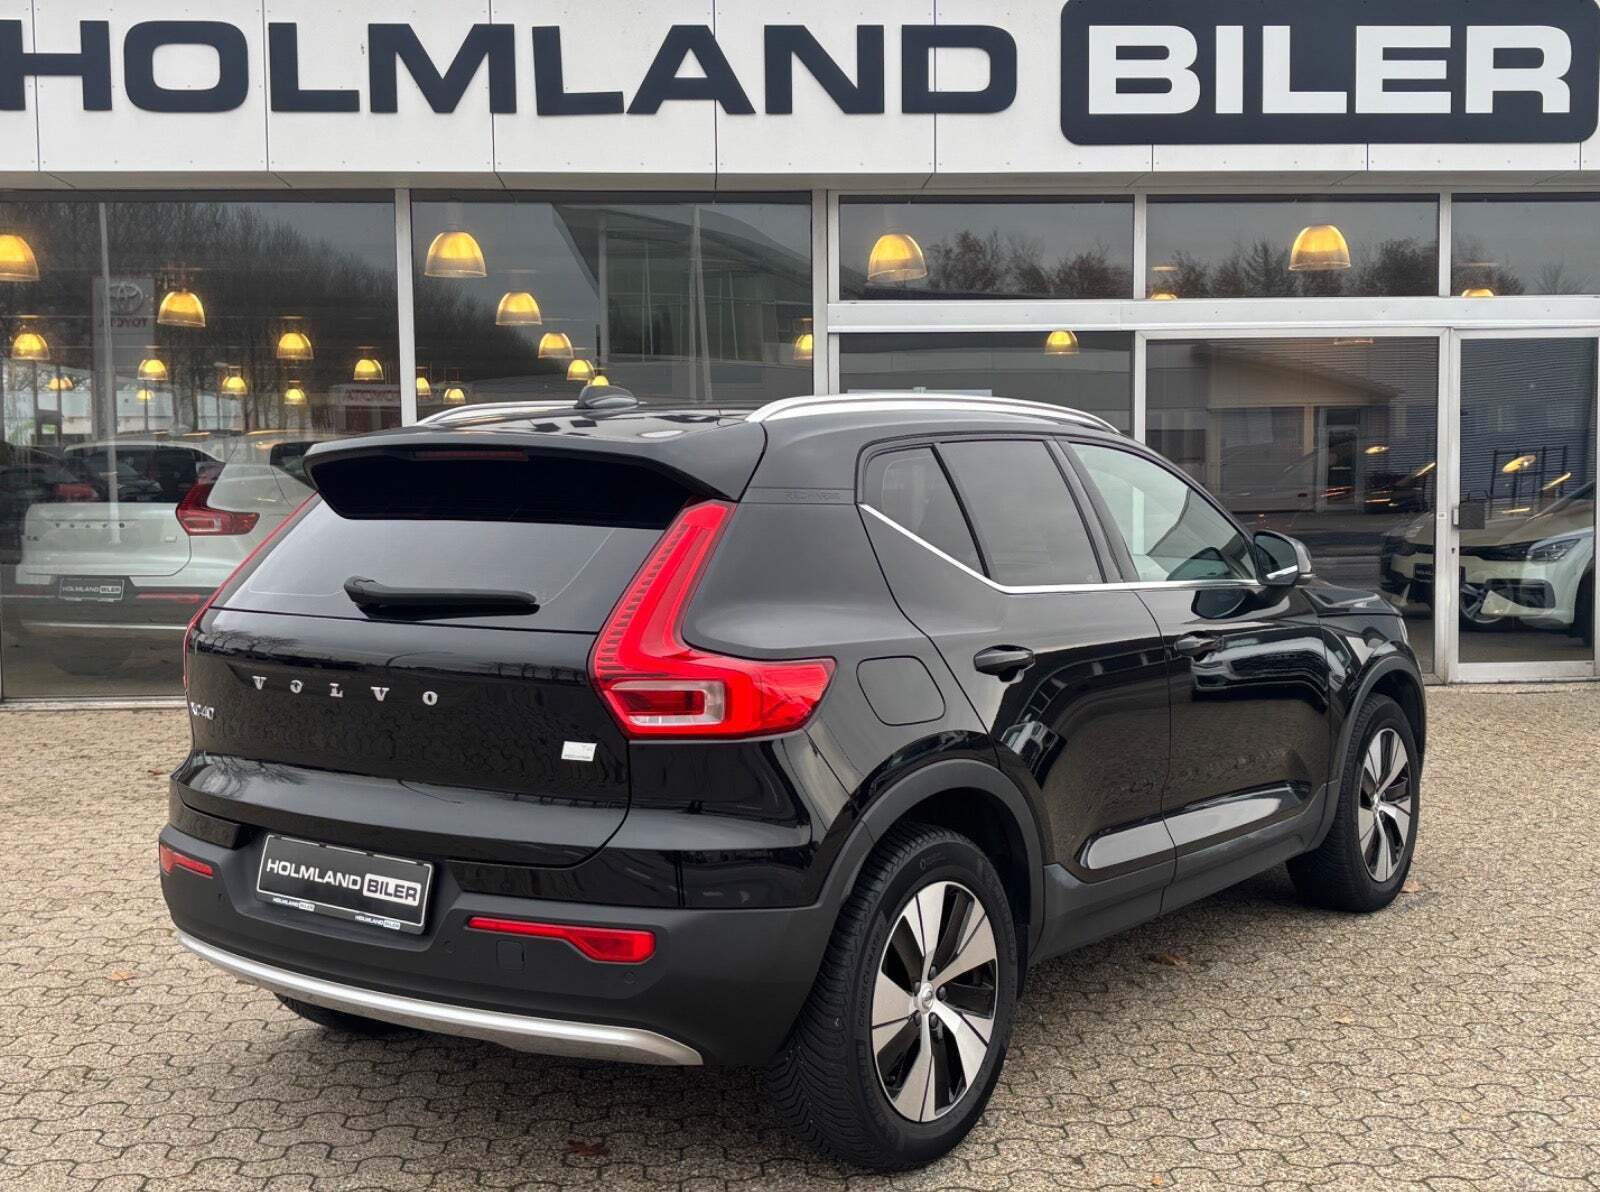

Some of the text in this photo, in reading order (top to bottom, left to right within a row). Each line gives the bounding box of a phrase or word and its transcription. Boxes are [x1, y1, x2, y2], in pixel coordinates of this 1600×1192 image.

[0, 20, 1571, 115] HOLMLAND BILER
[252, 675, 438, 706] VOLVO
[266, 858, 419, 903] HOLMLAND BILER
